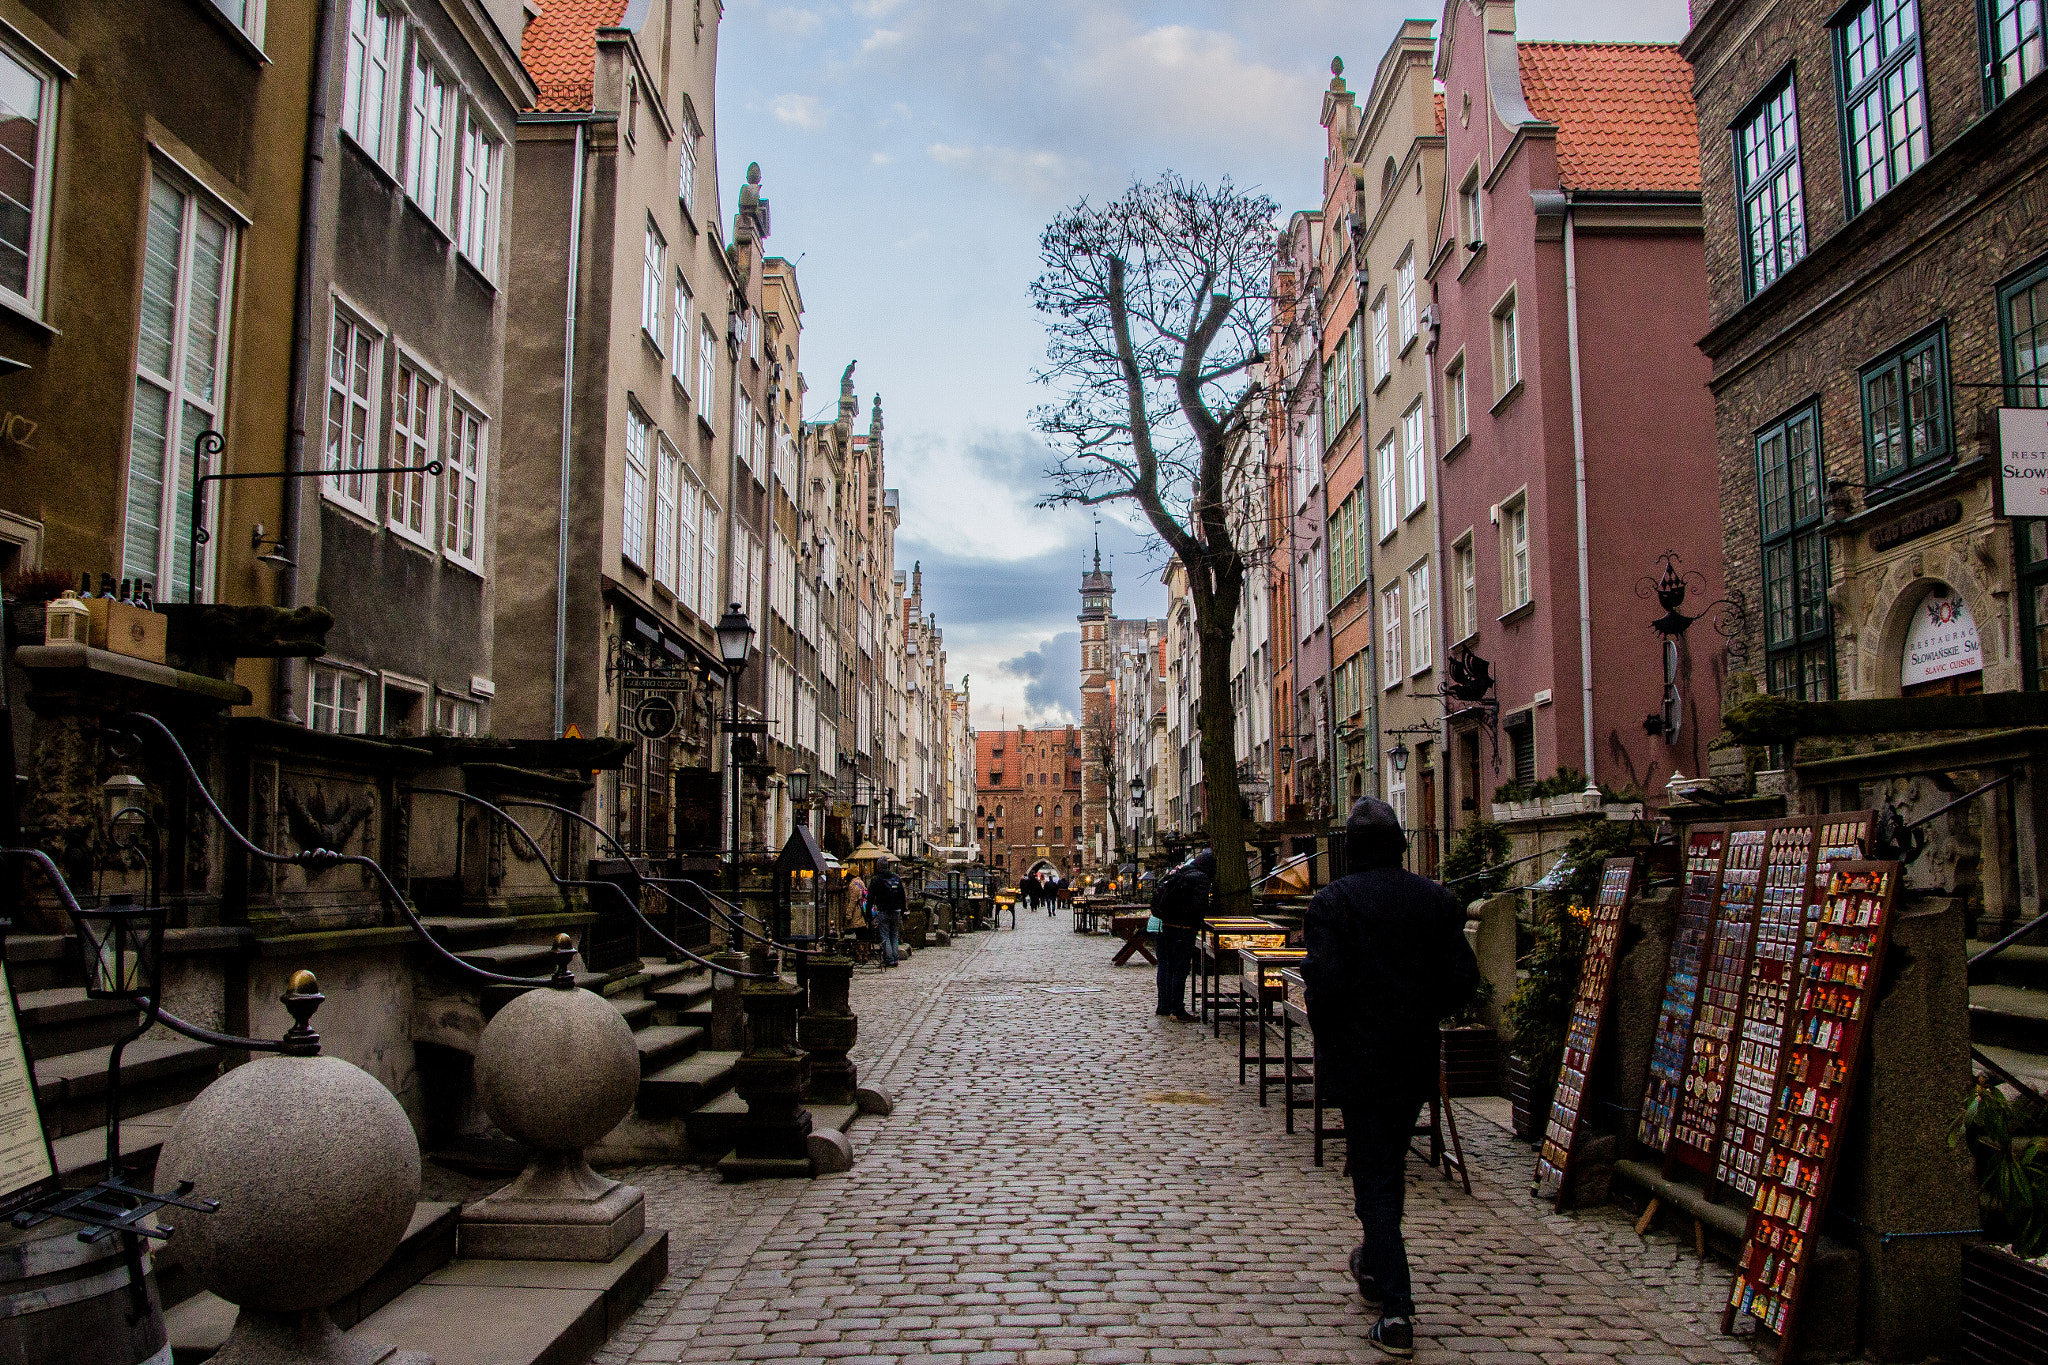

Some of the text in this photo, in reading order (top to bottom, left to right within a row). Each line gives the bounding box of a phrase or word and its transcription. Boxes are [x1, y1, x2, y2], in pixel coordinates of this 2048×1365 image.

[2002, 464, 2048, 479] SŁOW
[1925, 657, 1976, 676] SLAVIC CUISINE
